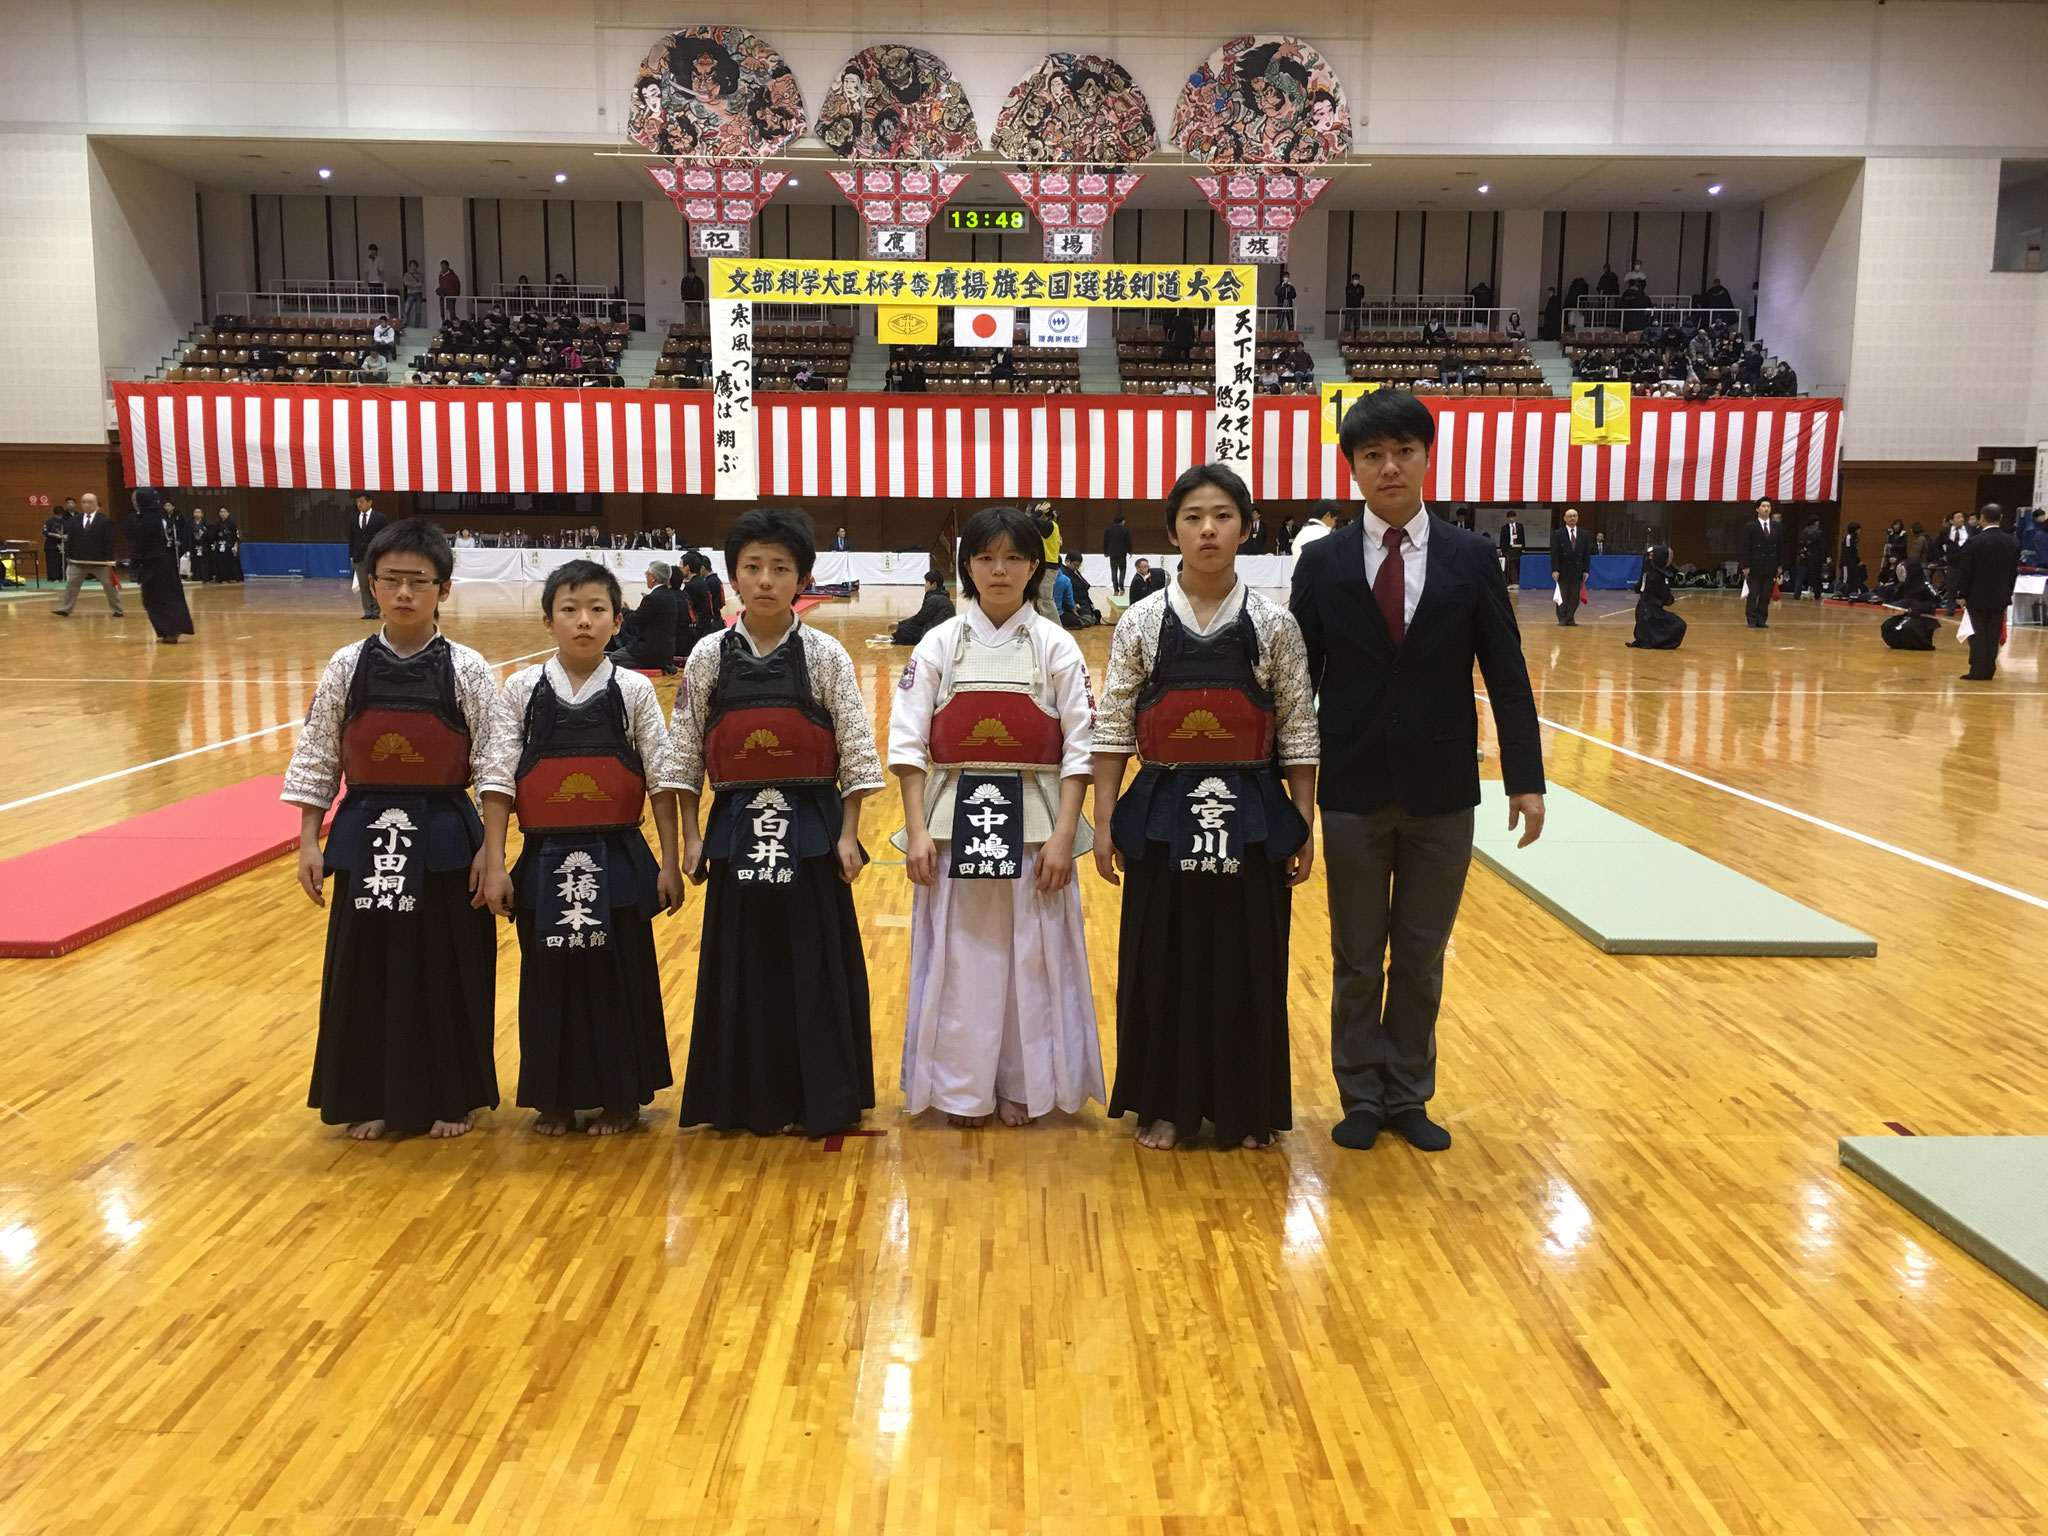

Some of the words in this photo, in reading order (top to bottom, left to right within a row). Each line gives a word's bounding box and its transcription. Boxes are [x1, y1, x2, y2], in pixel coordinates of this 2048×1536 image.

[952, 211, 1023, 228] 13:48
[705, 232, 733, 249] 祝
[884, 232, 906, 252] 鷹
[1061, 235, 1083, 254] 揚
[1246, 238, 1269, 255] 旗
[730, 303, 751, 412] 寒風ついて
[1233, 309, 1253, 460] 天下取るぞと
[1584, 384, 1605, 429] 1
[714, 370, 738, 473] 鷹は翔ぶ
[747, 810, 791, 867] 白井
[964, 806, 1010, 859] 中嶋
[1190, 799, 1236, 859] 宮川
[363, 828, 411, 894] 小田桐
[958, 861, 1017, 877] 四誠館
[1180, 857, 1241, 875] 四誠館
[737, 866, 794, 884] 四誠館
[355, 896, 416, 912] 四誠館
[557, 875, 602, 931] 橋本
[546, 932, 607, 949] 四誠館
